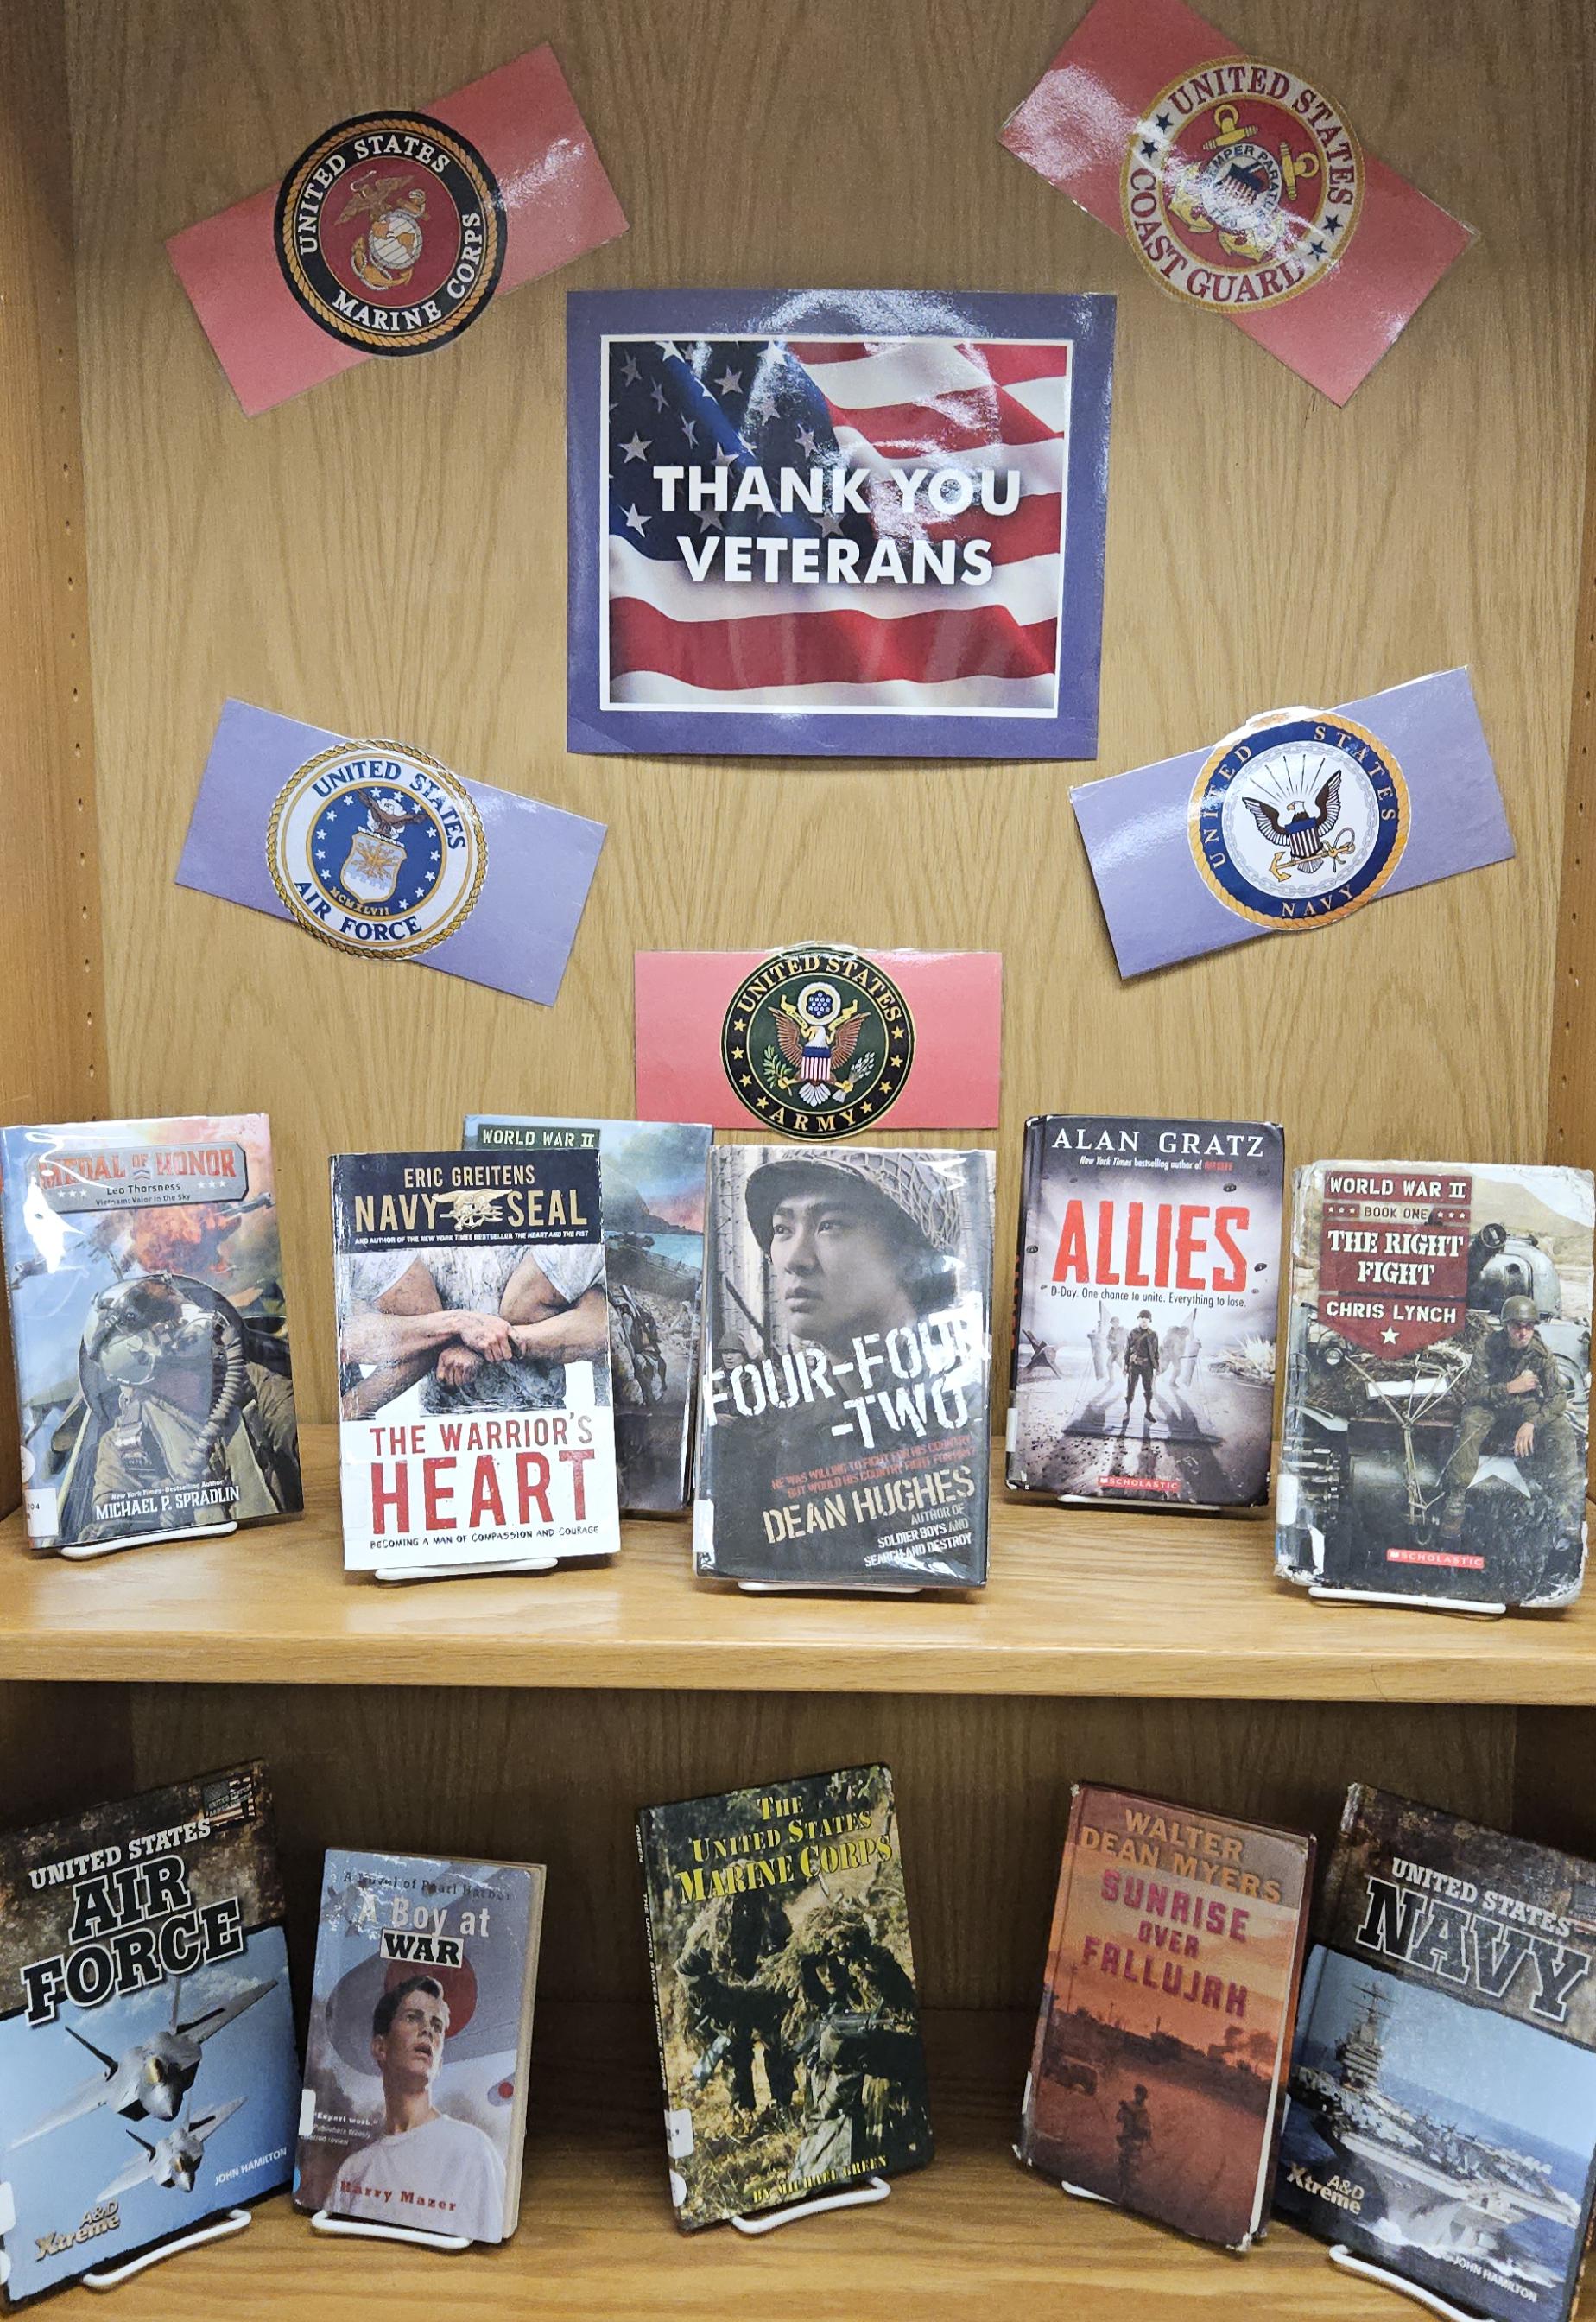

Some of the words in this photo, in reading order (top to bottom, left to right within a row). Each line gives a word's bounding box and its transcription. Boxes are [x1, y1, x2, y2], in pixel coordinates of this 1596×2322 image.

[1168, 66, 1290, 115] UNITED
[1292, 89, 1354, 205] STATES
[299, 155, 346, 255] UNITED
[354, 135, 451, 173] STATES
[1130, 168, 1188, 280] COAST
[1187, 257, 1306, 303] GUARD
[332, 289, 442, 332] MARINE
[447, 213, 484, 299] CORPS
[653, 466, 871, 515] THANK
[890, 470, 1021, 516] YOU
[677, 536, 993, 586] VETERANS
[1314, 726, 1396, 821] STATES
[312, 760, 401, 798] UNITED
[409, 773, 466, 850] STATES
[294, 881, 332, 922] AIR
[339, 916, 422, 940] FORCE
[1282, 884, 1352, 917] NAVY
[737, 956, 820, 1013] UNITED
[826, 956, 902, 1022] STATES
[482, 1128, 535, 1146] WORLD
[542, 1132, 574, 1147] WAR
[580, 1132, 595, 1148] II
[770, 1107, 856, 1132] ARMY
[1051, 1128, 1140, 1152] ALAN
[1158, 1132, 1264, 1158] GRATZ
[38, 1155, 126, 1190] MEDAL
[132, 1154, 149, 1168] OF
[155, 1149, 237, 1178] HONOR
[404, 1166, 443, 1189] ERIC
[451, 1164, 535, 1186] GREITENS
[1080, 1156, 1093, 1164] New
[1096, 1156, 1111, 1165] York
[1112, 1158, 1132, 1166] Times
[1134, 1158, 1168, 1171] bestselling
[1171, 1160, 1192, 1170] author
[1194, 1160, 1202, 1170] of
[106, 1187, 125, 1196] Leo
[128, 1183, 181, 1194] Thorsness
[133, 1196, 152, 1204] Valor
[178, 1194, 190, 1202] Sky
[1329, 1177, 1394, 1195] WORLD
[1403, 1180, 1442, 1198] WAR
[1449, 1182, 1466, 1199] II
[354, 1194, 439, 1232] NAVY
[507, 1189, 587, 1228] SEAL
[1364, 1206, 1397, 1219] BOOK
[1403, 1208, 1428, 1220] ONE
[1052, 1199, 1249, 1292] ALLIES
[1327, 1229, 1378, 1253] THE
[1384, 1231, 1464, 1258] RIGHT
[1357, 1260, 1435, 1285] FIGHT
[1051, 1285, 1078, 1298] D-Day.
[1082, 1288, 1099, 1297] One
[1101, 1291, 1129, 1301] chance
[1131, 1291, 1140, 1301] to
[1143, 1292, 1166, 1303] unite.
[1169, 1292, 1213, 1308] Everything
[1216, 1296, 1225, 1306] to
[1227, 1297, 1247, 1308] lose.
[1326, 1301, 1384, 1319] CHRIS
[1393, 1304, 1456, 1324] LYNCH
[370, 1424, 425, 1456] THE
[439, 1412, 594, 1453] WARRIOR'S
[127, 1490, 142, 1499] York
[370, 1448, 596, 1535] HEART
[788, 1474, 808, 1485] WAS
[808, 1465, 846, 1481] WILLING
[788, 1486, 805, 1499] BUT
[808, 1477, 842, 1493] WOULD
[1109, 1477, 1178, 1490] SCHOLASTIC
[96, 1498, 159, 1520] MICHAEL
[161, 1495, 173, 1512] P.
[175, 1486, 240, 1509] SPRADLIN
[762, 1493, 846, 1545] DEAN
[852, 1465, 975, 1524] HUGHES
[911, 1507, 951, 1526] AUTHOR
[952, 1503, 966, 1515] OF
[370, 1538, 419, 1550] BECOMING
[433, 1536, 453, 1545] MAN
[456, 1534, 467, 1543] OF
[472, 1531, 533, 1543] COMPASSION
[536, 1529, 554, 1538] AND
[559, 1526, 599, 1536] COURAGE
[864, 1548, 905, 1567] SEARCH
[905, 1544, 926, 1558] AND
[927, 1532, 972, 1553] DESTROY
[877, 1530, 919, 1548] SOLDIER
[919, 1523, 947, 1538] BOYS
[948, 1518, 969, 1532] AND
[1401, 1551, 1484, 1567] SCHOLASTIC
[757, 1795, 803, 1821] THE
[28, 1845, 122, 1890] UNITED
[129, 1818, 211, 1861] STATES
[689, 1828, 781, 1862] UNITED
[788, 1811, 872, 1843] STATES
[1125, 1809, 1244, 1862] WALTER
[344, 1872, 352, 1882] A
[404, 1879, 416, 1889] of
[675, 1855, 795, 1905] MARINE
[800, 1835, 893, 1878] CORPS
[1079, 1826, 1161, 1869] DEAN
[1173, 1852, 1282, 1904] MYERS
[68, 1854, 192, 1945] AIR
[359, 1895, 377, 1923] A
[392, 1896, 449, 1937] Boy
[459, 1907, 491, 1938] at
[1101, 1869, 1250, 1943] SUNRISE
[1392, 1857, 1478, 1904] UNITED
[1482, 1890, 1573, 1938] STATES
[383, 1933, 459, 1966] WAR
[1138, 1920, 1200, 1959] OVER
[1356, 1876, 1591, 2022] NAVY
[20, 1896, 244, 2027] FORCE
[1083, 1935, 1249, 2018] FALLUJAH
[214, 2168, 240, 2186] JOHN
[240, 2146, 287, 2175] HAMILTON
[753, 2188, 770, 2203] BY
[843, 2155, 888, 2177] GREEN
[340, 2180, 392, 2203] Harry
[401, 2191, 457, 2211] Mazer
[1287, 2163, 1361, 2217] Xtreme
[1327, 2174, 1365, 2201] A&D
[79, 2198, 119, 2228] A&D
[35, 2215, 121, 2263] Xtreme
[1454, 2255, 1482, 2276] JOHN
[1483, 2268, 1538, 2303] HAMILTON
